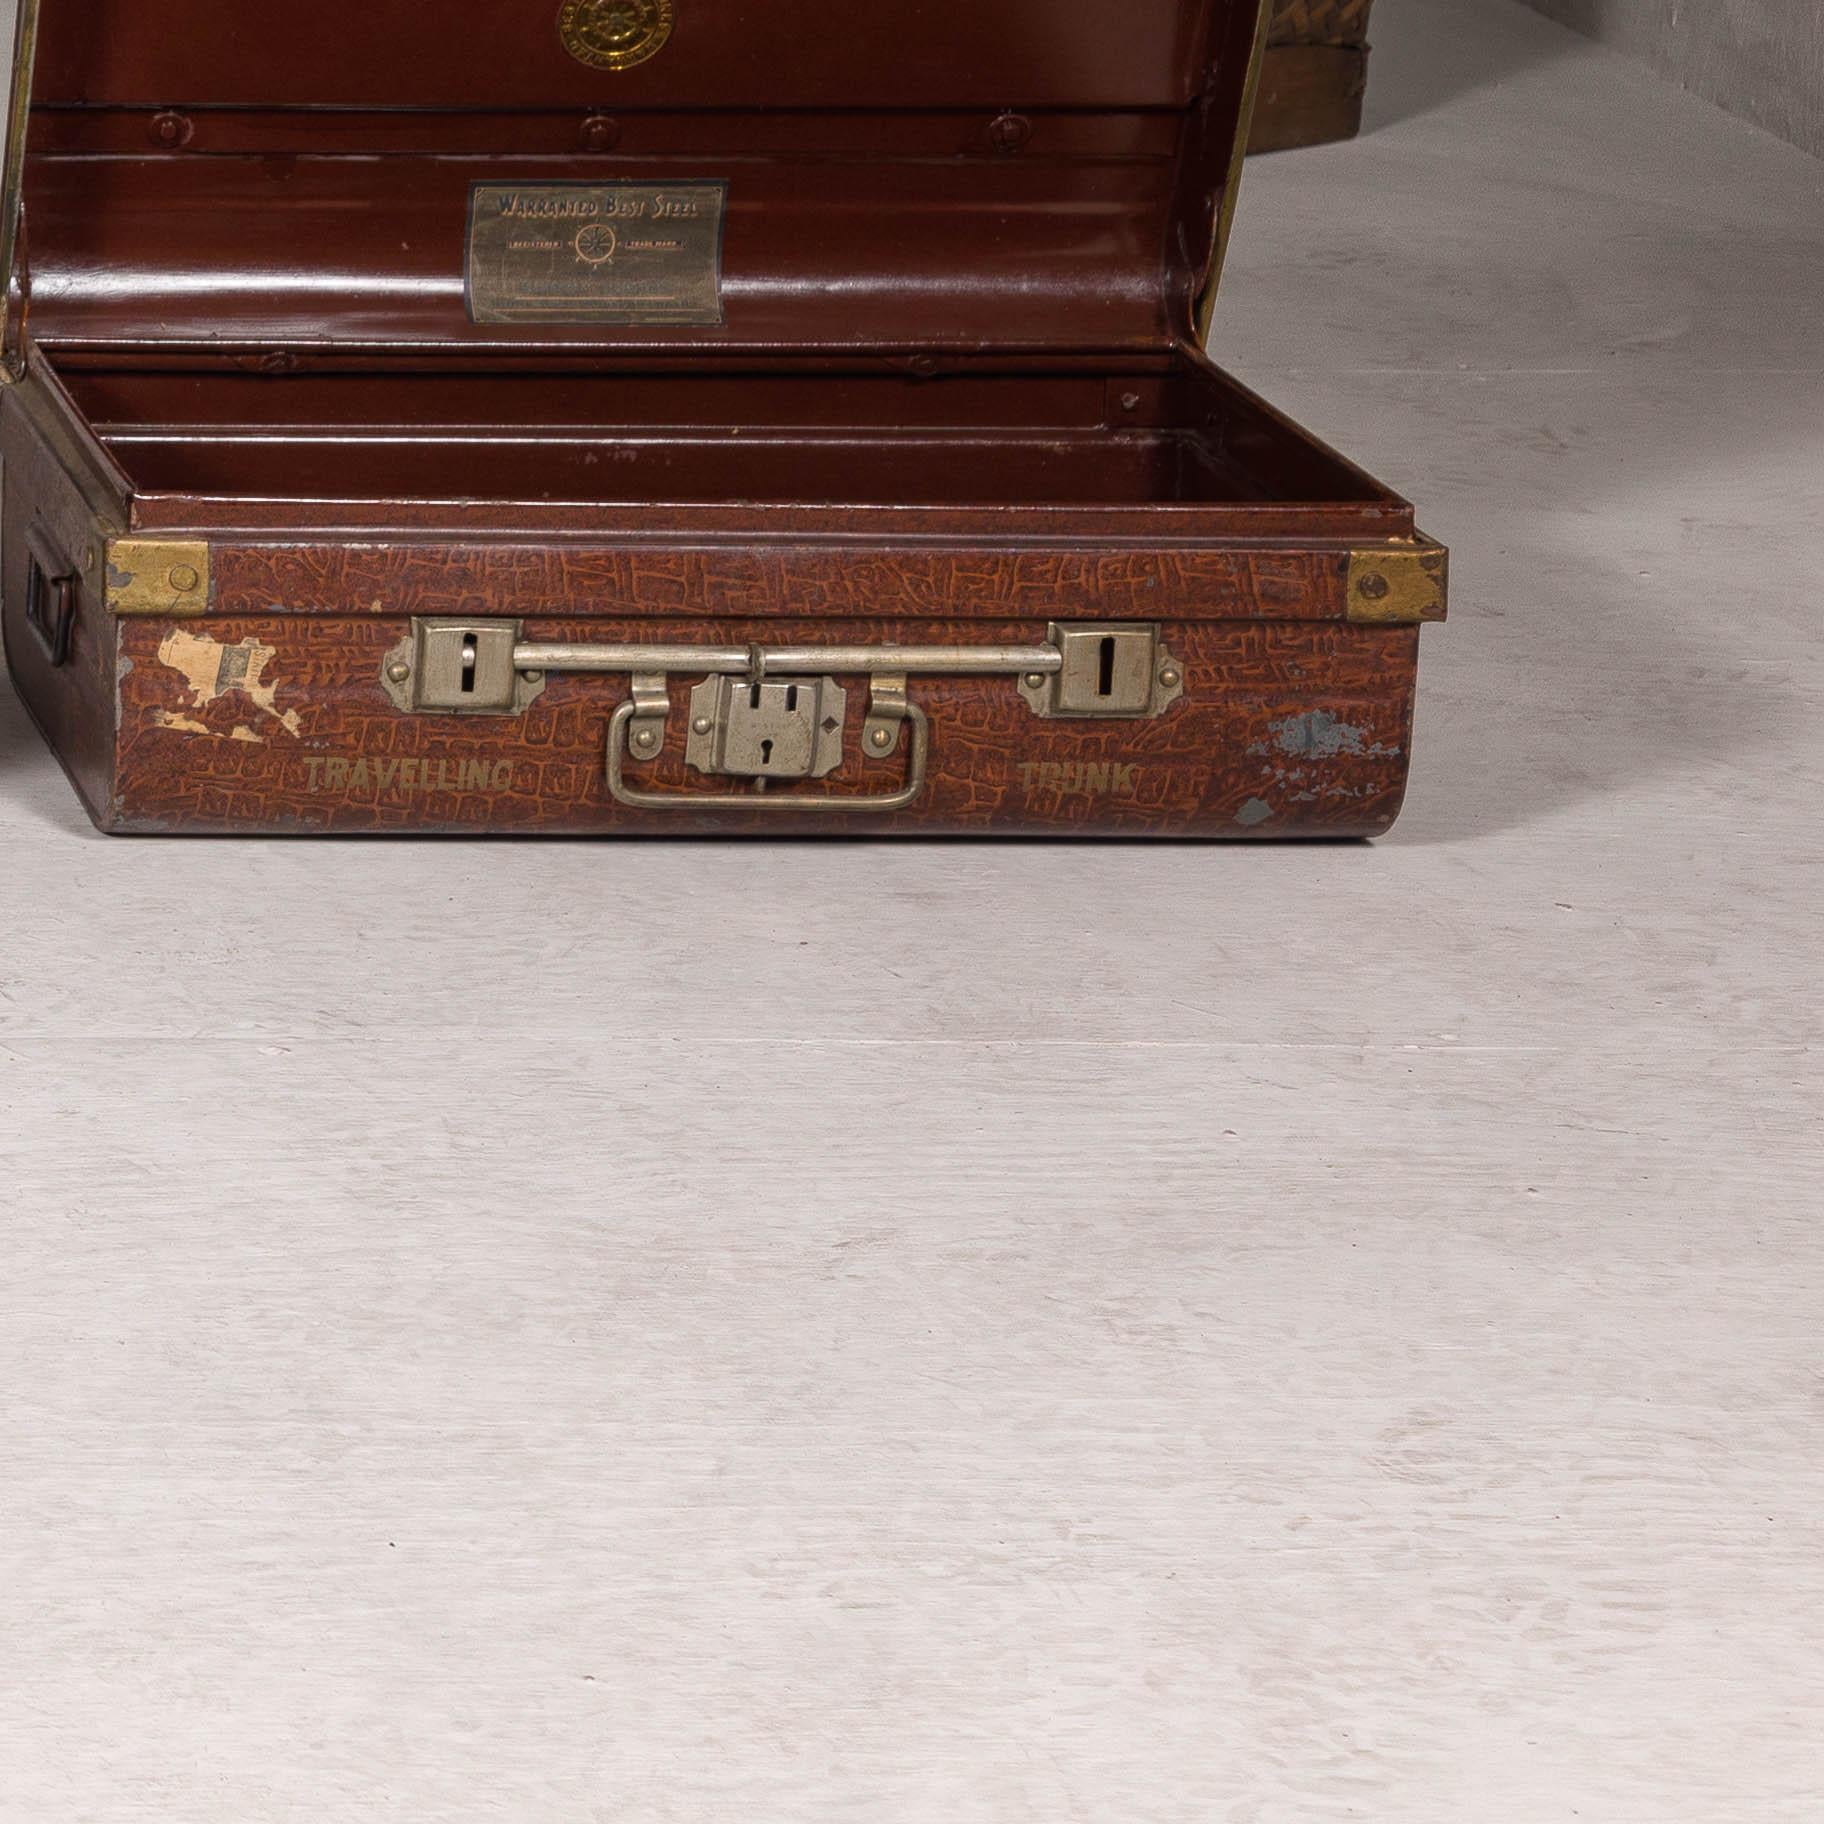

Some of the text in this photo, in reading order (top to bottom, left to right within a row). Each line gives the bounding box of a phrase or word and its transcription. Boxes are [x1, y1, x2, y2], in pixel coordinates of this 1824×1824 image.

[497, 192, 700, 219] WARRANTED BEST STEEL
[302, 756, 1139, 795] TRAVELLING TRUNK
